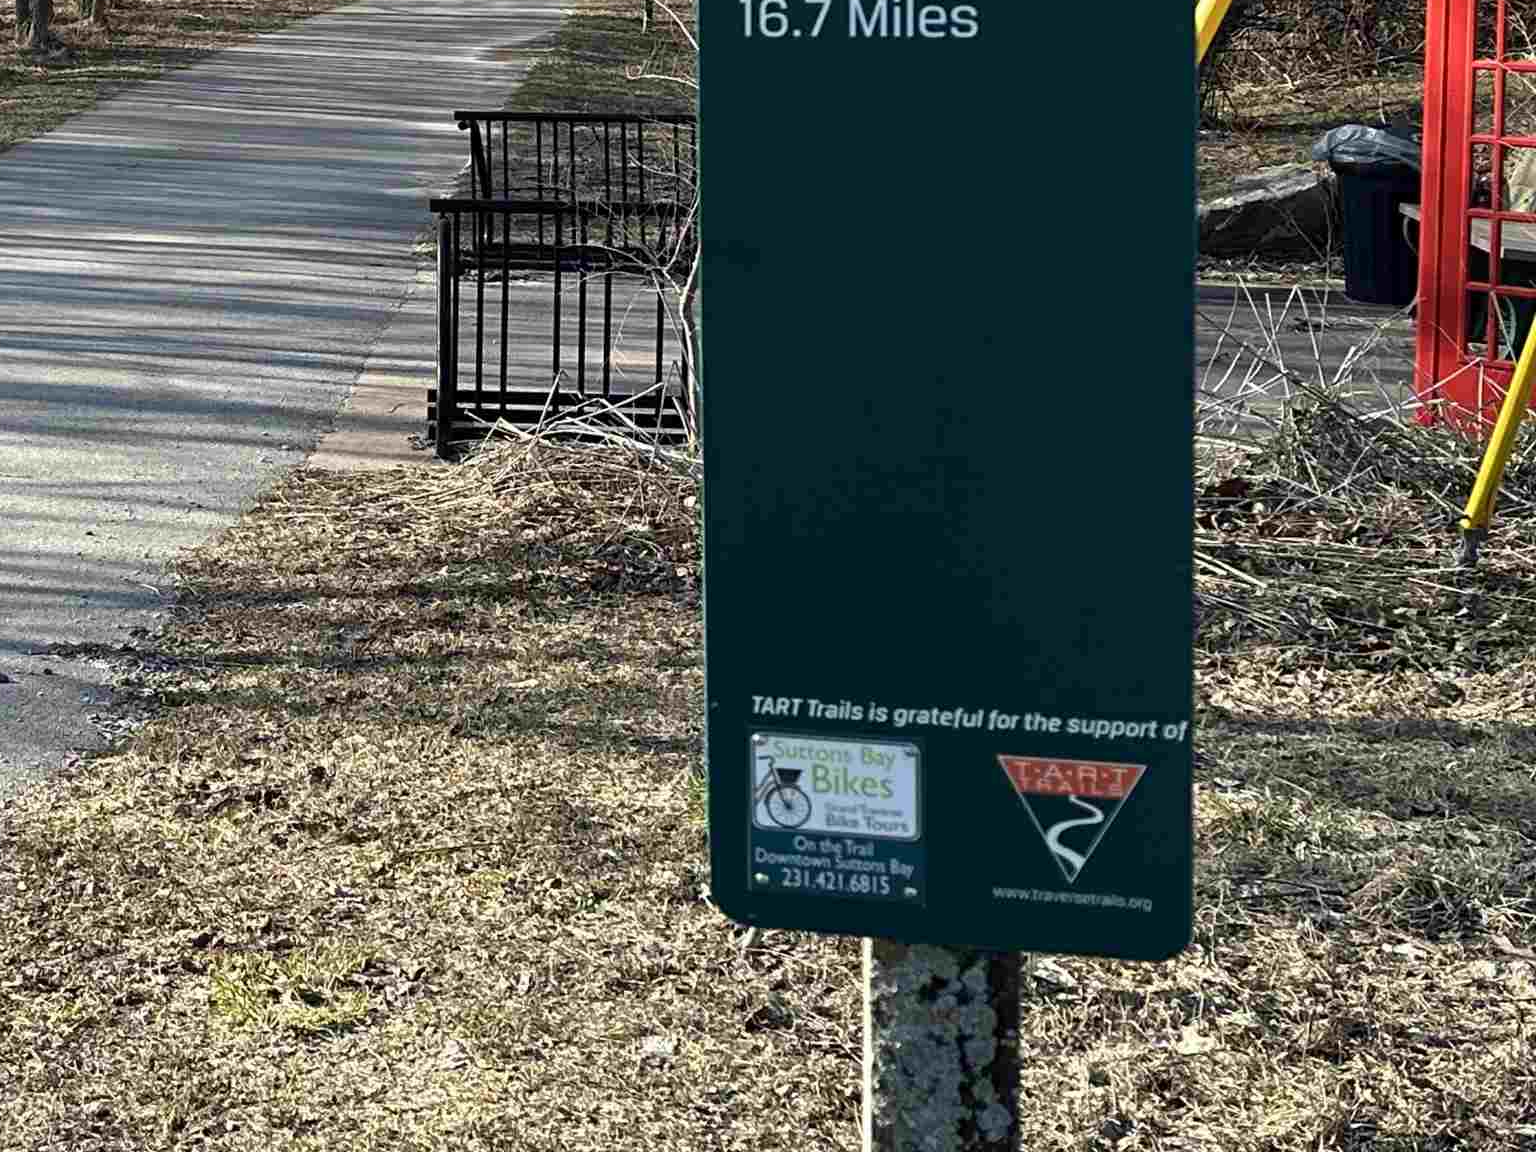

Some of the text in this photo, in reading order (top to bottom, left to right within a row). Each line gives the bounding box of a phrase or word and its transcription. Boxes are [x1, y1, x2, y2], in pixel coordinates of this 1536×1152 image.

[752, 695, 1188, 742] TART Trails is grateful for the support of
[773, 739, 896, 770] Suttons Bay
[812, 764, 894, 799] Bikes
[865, 816, 910, 834] Tours
[793, 835, 875, 857] On the Trail
[754, 847, 915, 879] Downtown Suttons Bay
[781, 867, 891, 895] 231.421.6815
